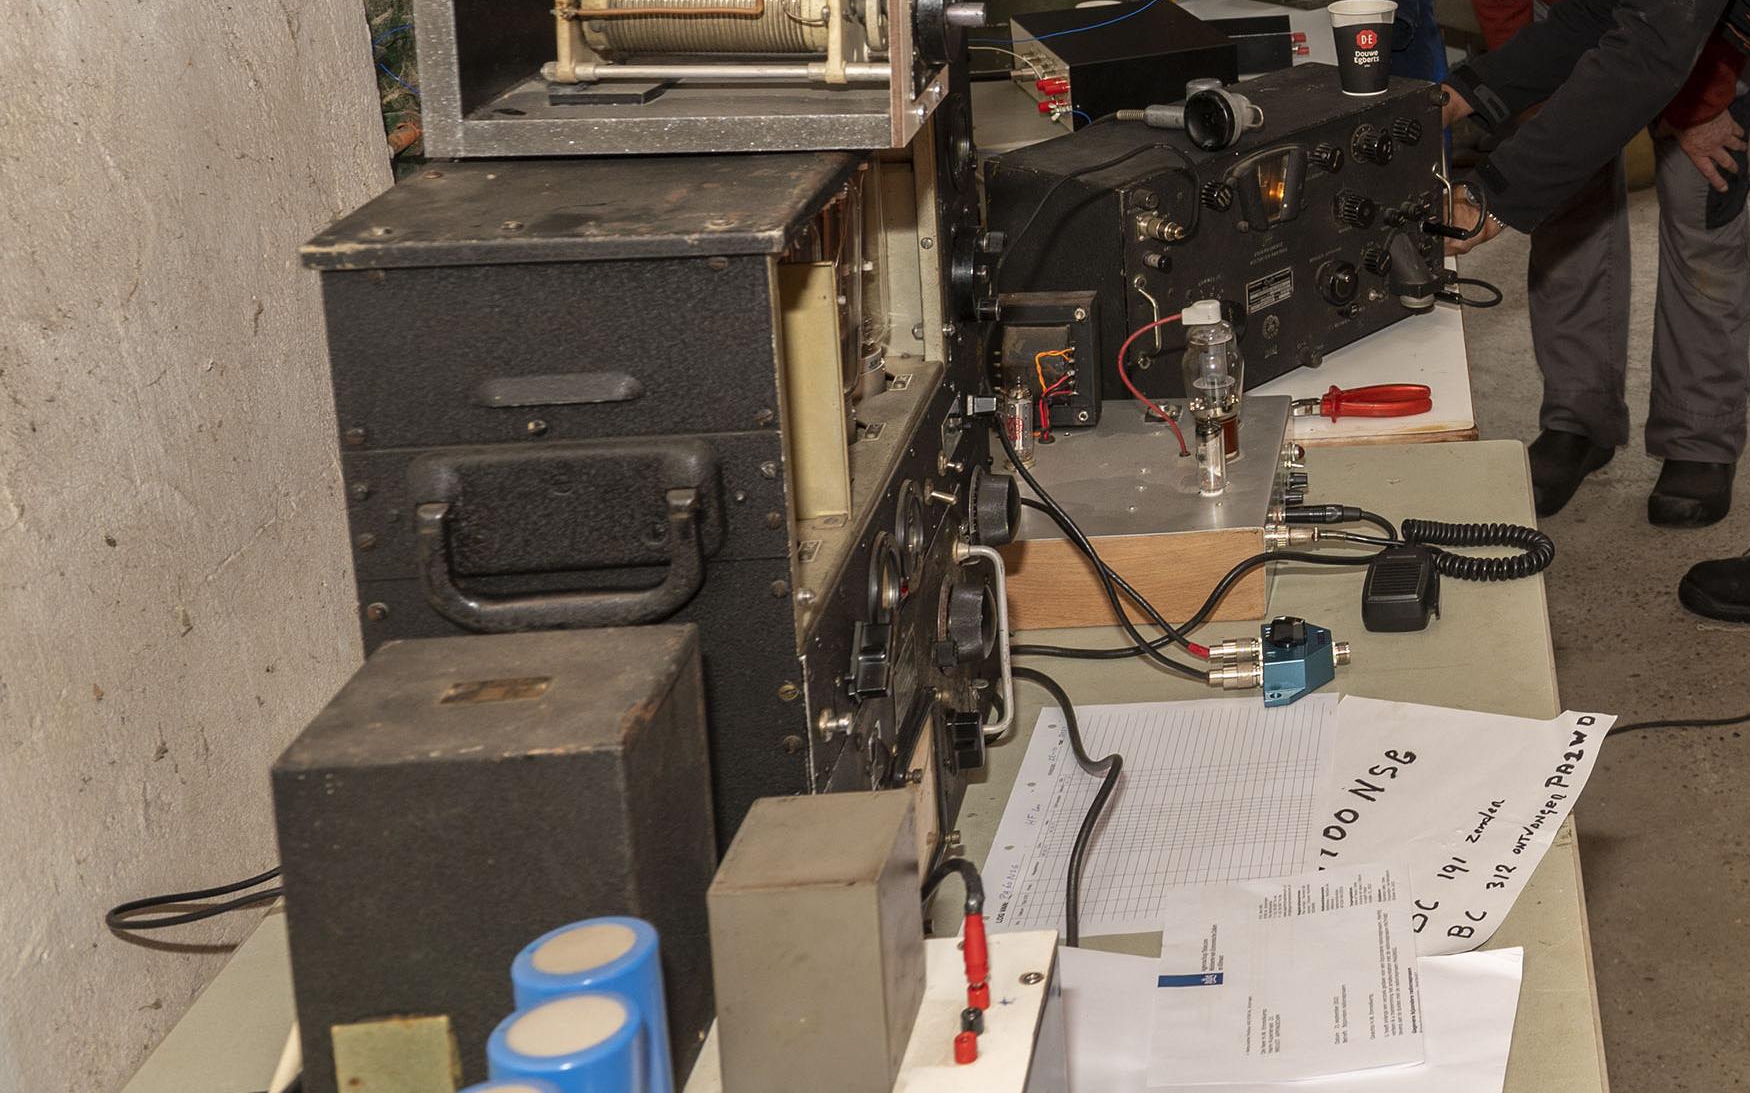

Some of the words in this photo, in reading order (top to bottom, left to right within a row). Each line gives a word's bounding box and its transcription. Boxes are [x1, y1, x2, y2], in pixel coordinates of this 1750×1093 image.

[1353, 55, 1380, 65] Egberts
[1354, 50, 1379, 58] Douwe
[1437, 856, 1470, 880] 191
[1485, 864, 1518, 890] 312
